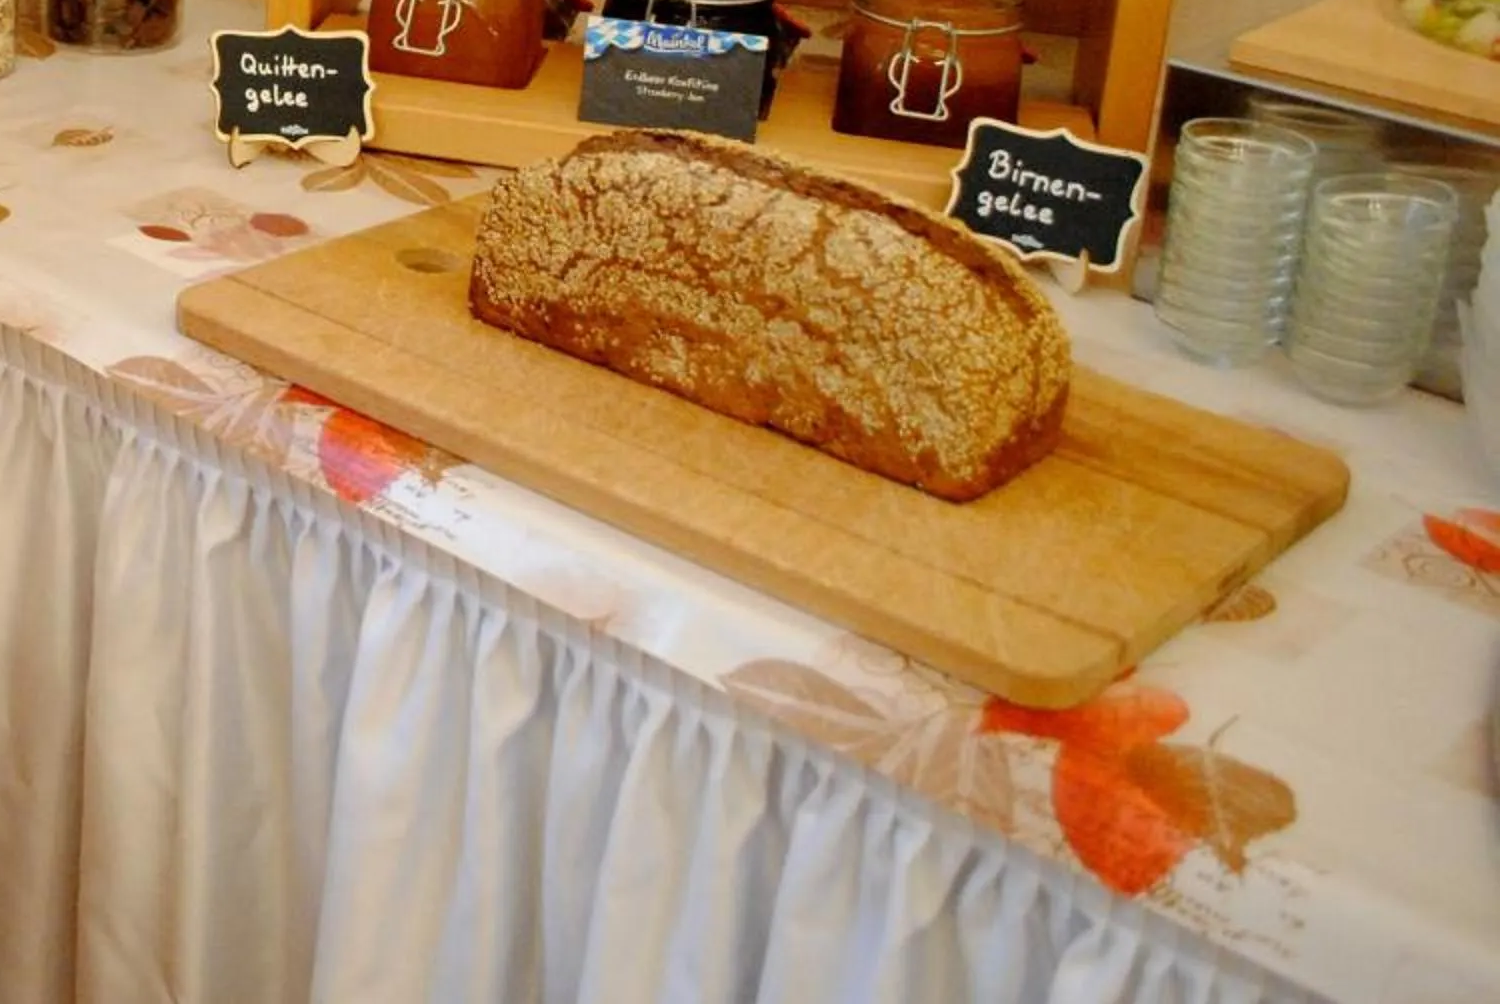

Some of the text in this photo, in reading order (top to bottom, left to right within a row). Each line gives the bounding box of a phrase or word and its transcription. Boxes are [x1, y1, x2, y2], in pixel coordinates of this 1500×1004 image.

[239, 51, 338, 79] Quitten-
[244, 83, 309, 113] gelee
[987, 148, 1102, 202] Birnen-
[976, 190, 1055, 226] gelee
